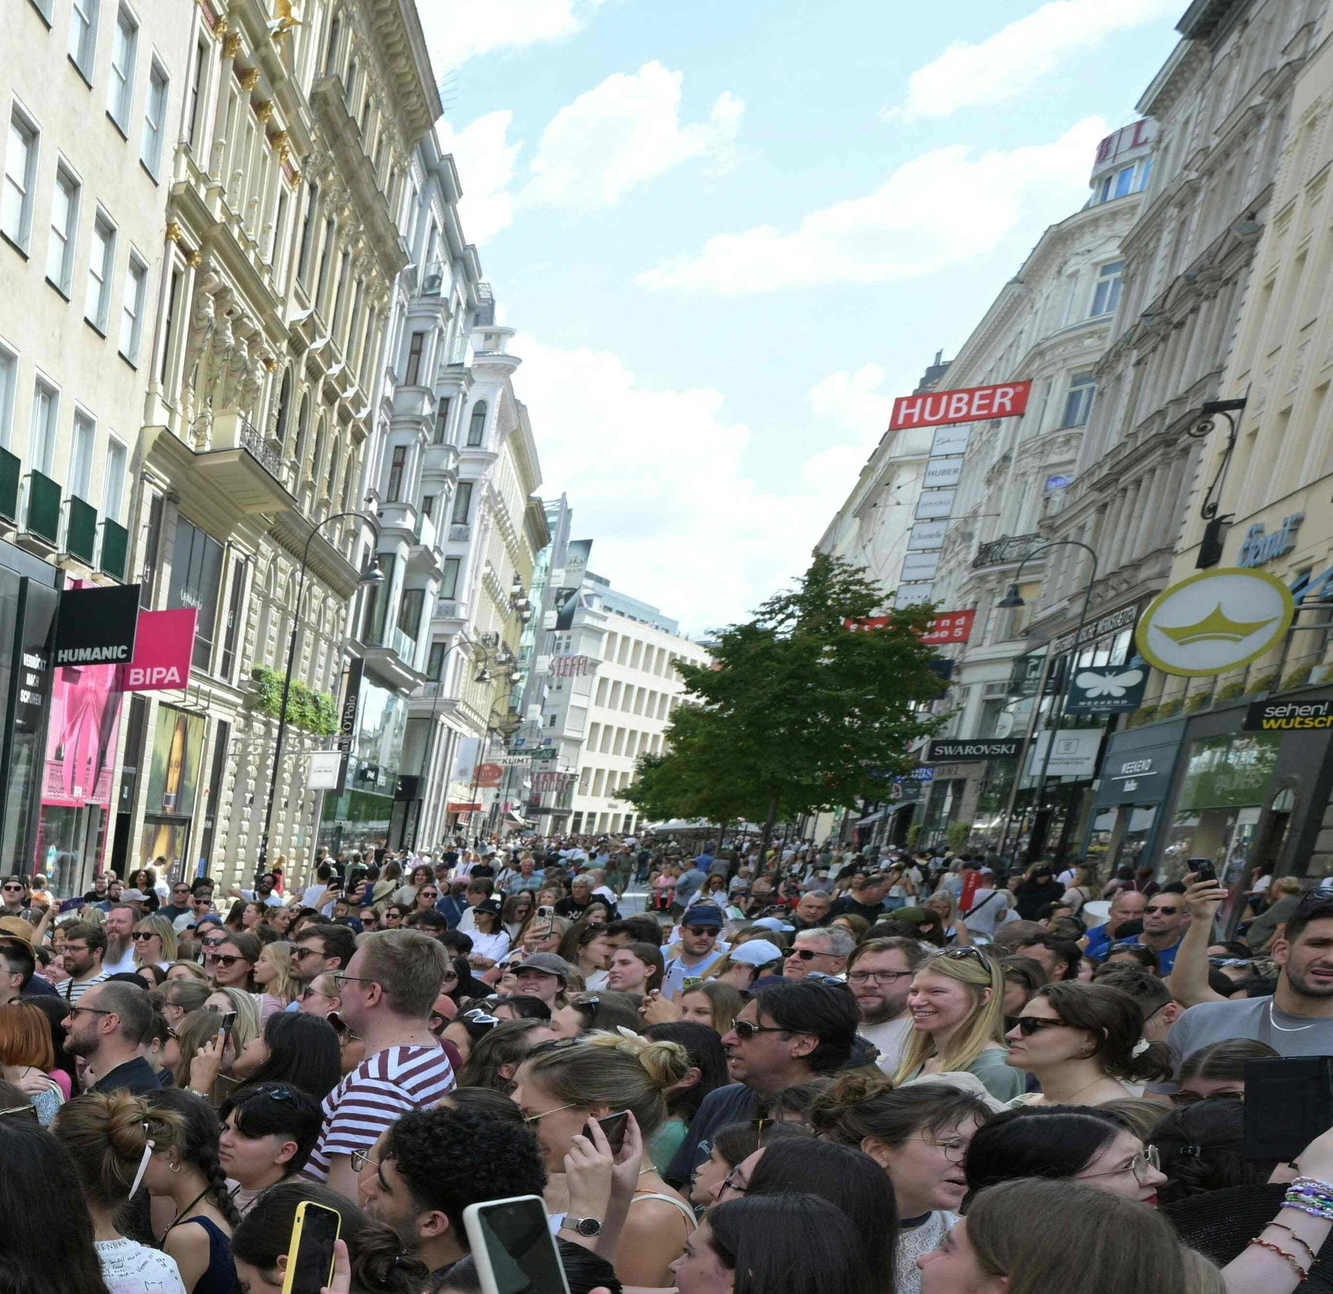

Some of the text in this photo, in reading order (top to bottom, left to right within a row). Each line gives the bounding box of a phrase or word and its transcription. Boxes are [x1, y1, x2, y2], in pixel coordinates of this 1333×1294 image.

[897, 387, 1014, 425] HUBER
[927, 467, 959, 478] HUBER
[57, 645, 129, 663] HUMANIC
[129, 666, 181, 686] BIPA
[1263, 702, 1329, 717] sehen!
[934, 744, 1016, 756] SWAROVSKI
